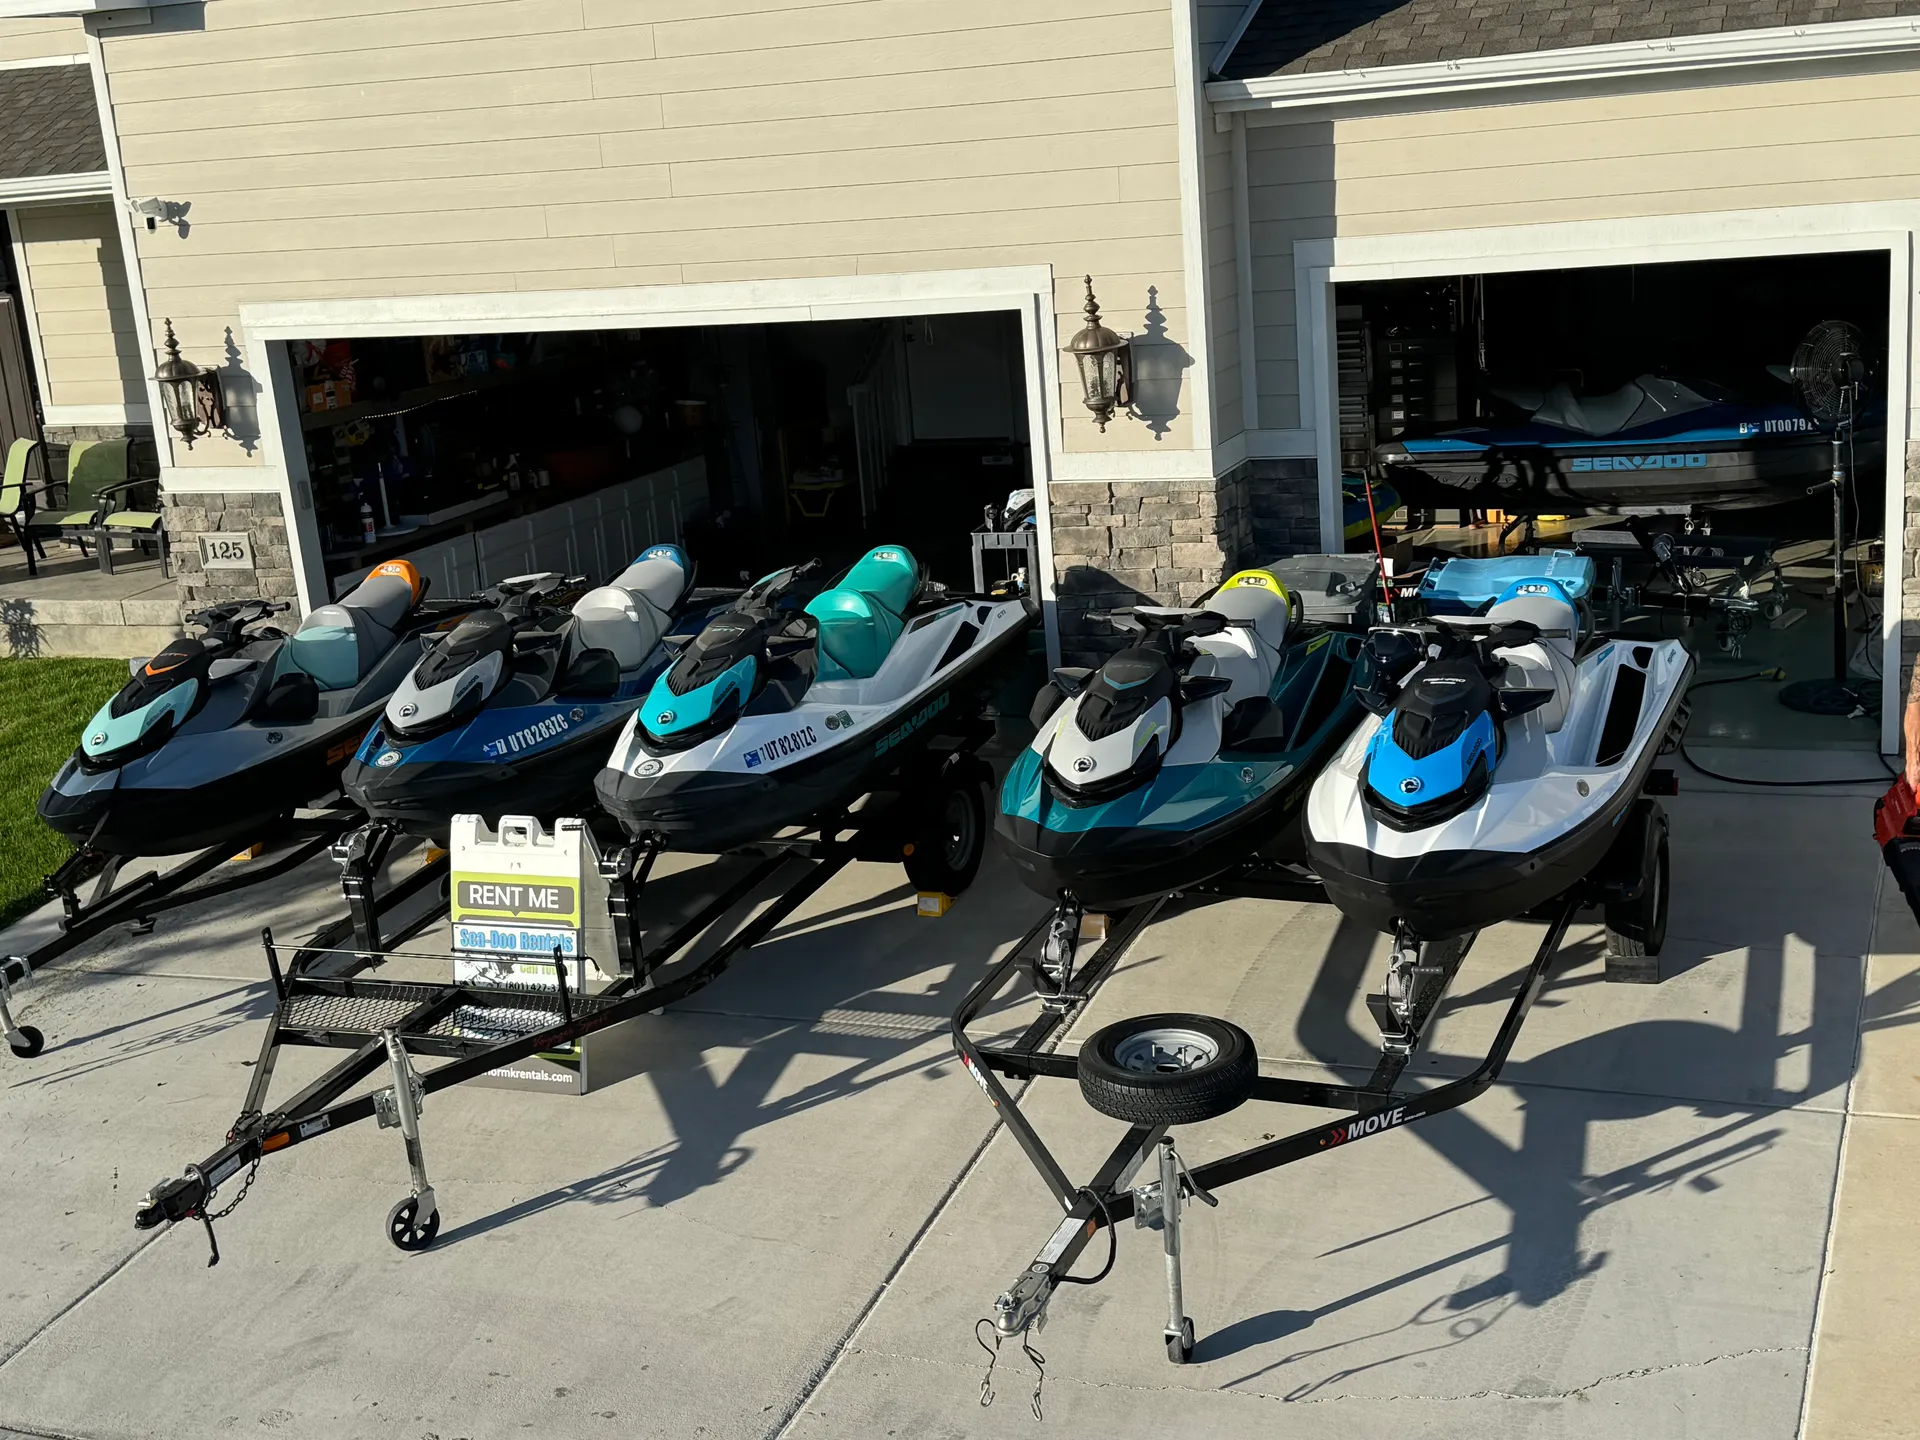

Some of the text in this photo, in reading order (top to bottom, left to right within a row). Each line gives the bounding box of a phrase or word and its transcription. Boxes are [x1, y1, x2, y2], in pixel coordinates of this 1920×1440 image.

[209, 541, 245, 560] 125
[469, 884, 559, 909] RENT ME
[460, 928, 573, 953] Sea-Doo Rentals
[505, 980, 529, 991] (801)
[481, 1066, 574, 1083] ormkrentals.com
[968, 1057, 989, 1095] MOVE
[1347, 1106, 1405, 1139] MOVE
